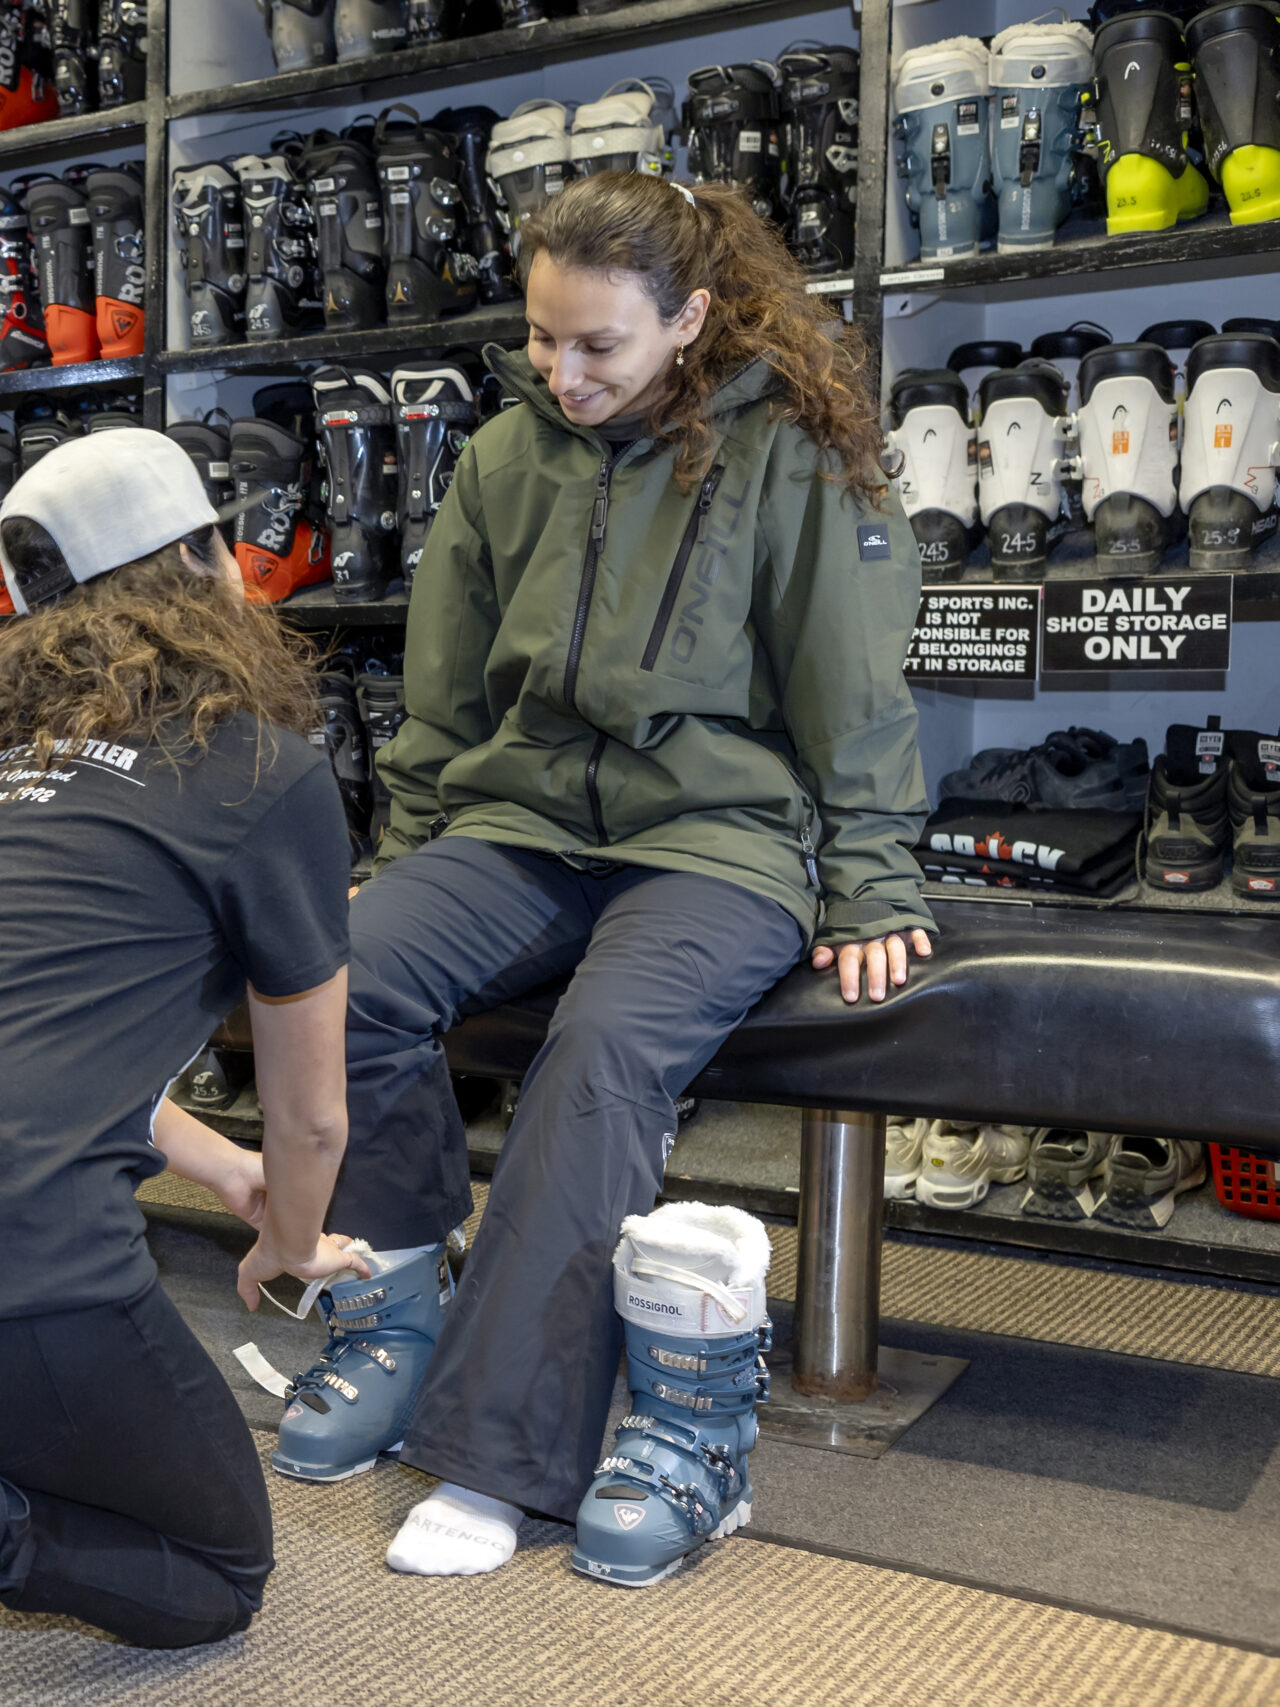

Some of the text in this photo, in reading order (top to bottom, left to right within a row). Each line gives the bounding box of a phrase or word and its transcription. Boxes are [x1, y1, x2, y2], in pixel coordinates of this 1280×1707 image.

[928, 597, 994, 610] SPORTS
[998, 597, 1034, 610] INC.
[1082, 587, 1192, 613] DAILY
[925, 612, 981, 625] IS NOT
[1046, 614, 1227, 633] SHOE STORAGE
[995, 628, 1030, 641] FOR
[919, 643, 1027, 656] BELONGINGS
[1084, 635, 1186, 661] ONLY
[925, 658, 942, 671] IN
[947, 659, 1026, 672] STORAGE
[629, 1295, 683, 1316] ROSSIGNOL
[409, 1514, 505, 1551] ARTENGO
